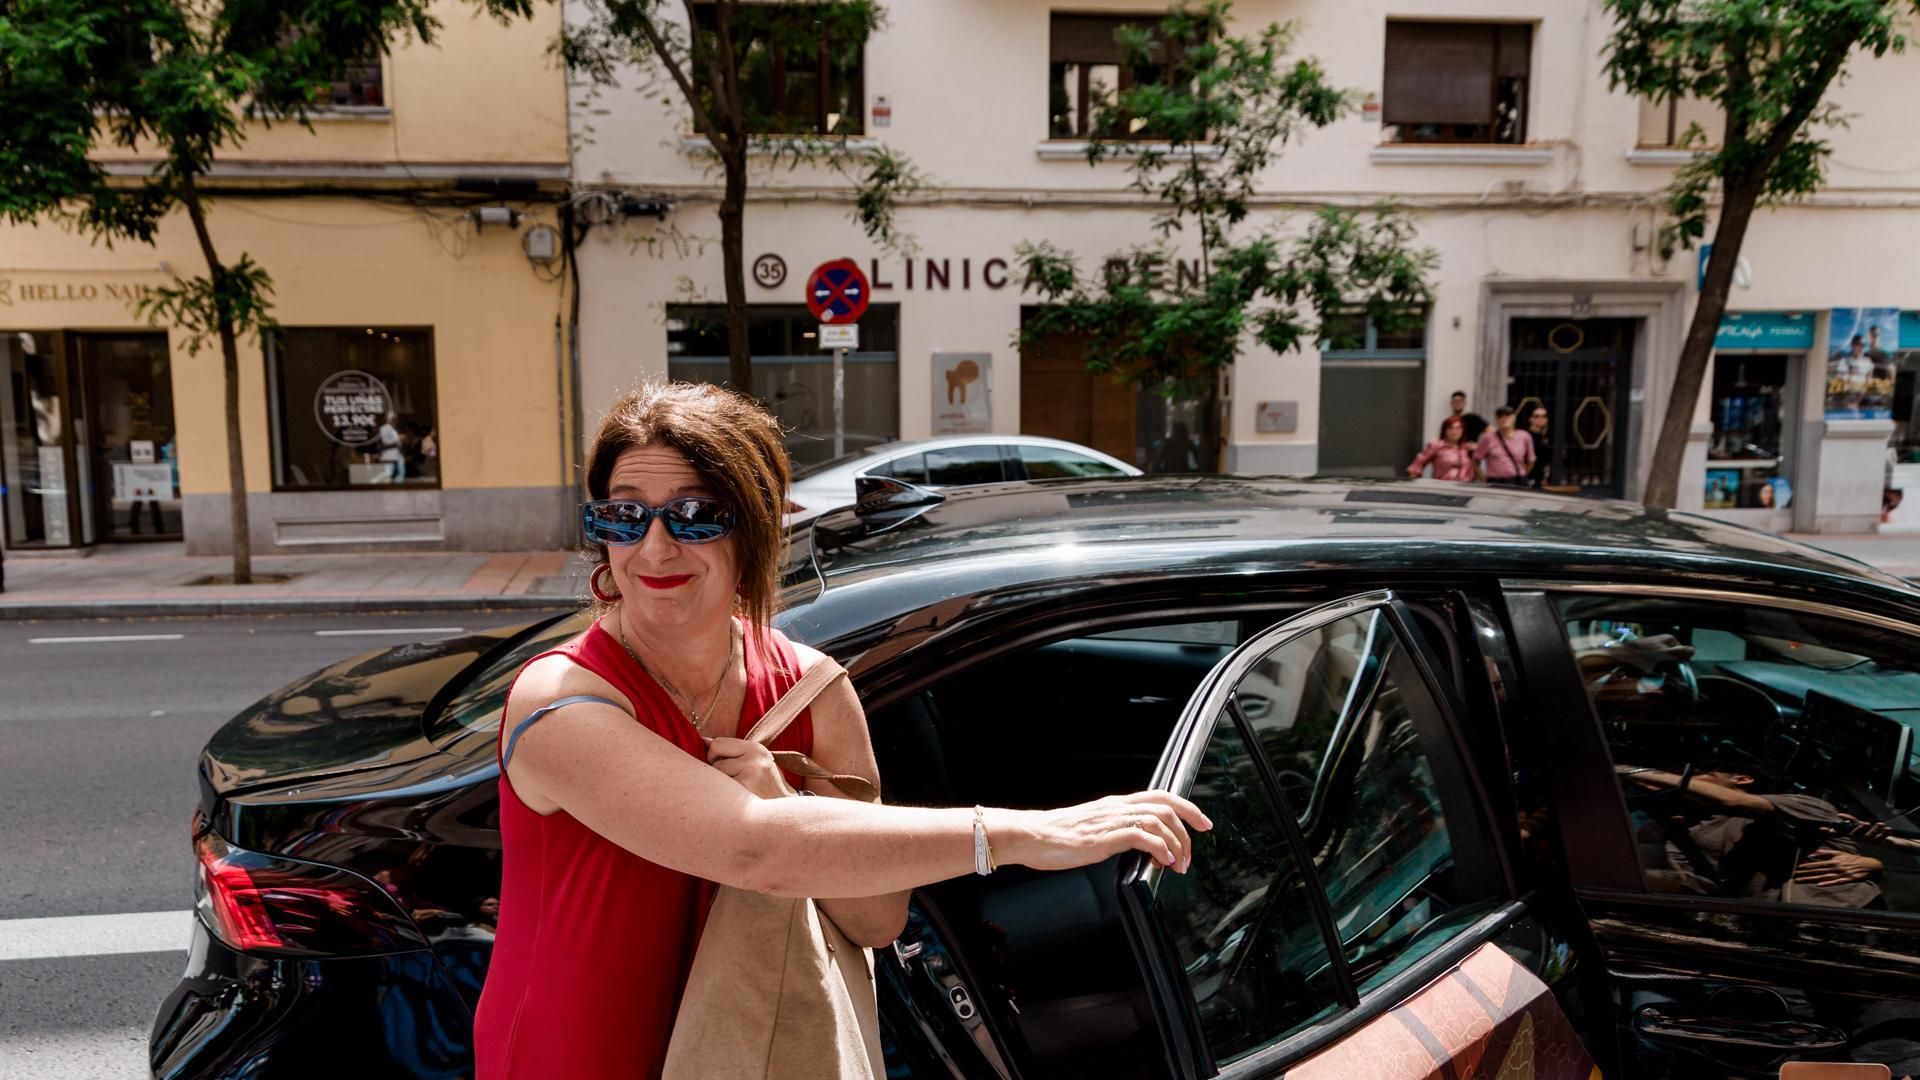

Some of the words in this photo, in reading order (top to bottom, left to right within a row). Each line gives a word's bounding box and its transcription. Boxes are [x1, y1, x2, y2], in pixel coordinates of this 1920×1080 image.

[759, 262, 781, 280] 35
[842, 257, 1054, 292] LINICA
[19, 283, 98, 301] HELLO
